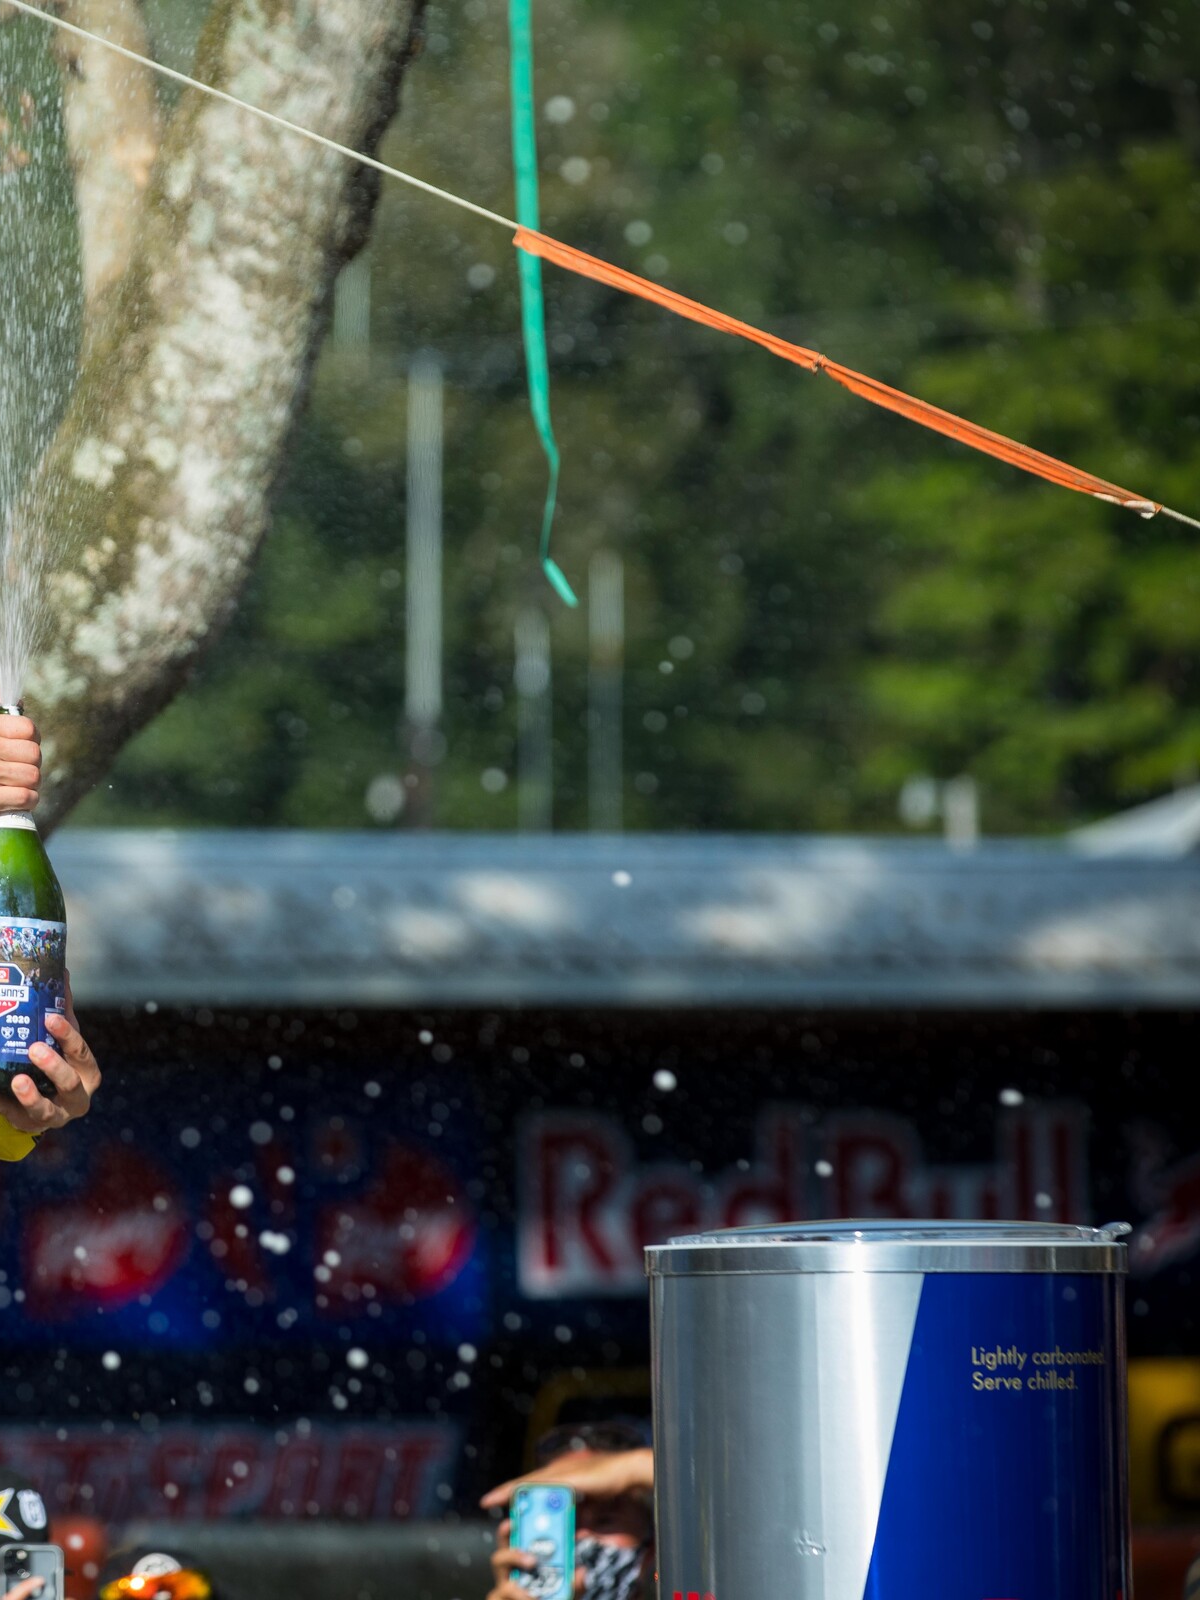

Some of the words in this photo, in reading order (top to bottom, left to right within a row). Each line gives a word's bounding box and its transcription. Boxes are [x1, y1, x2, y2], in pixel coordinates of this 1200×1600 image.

[6, 1014, 31, 1025] 2020
[530, 1112, 805, 1278] Red
[971, 1345, 1028, 1371] Lightly
[972, 1371, 1023, 1391] Serve
[1027, 1370, 1079, 1391] chilled.
